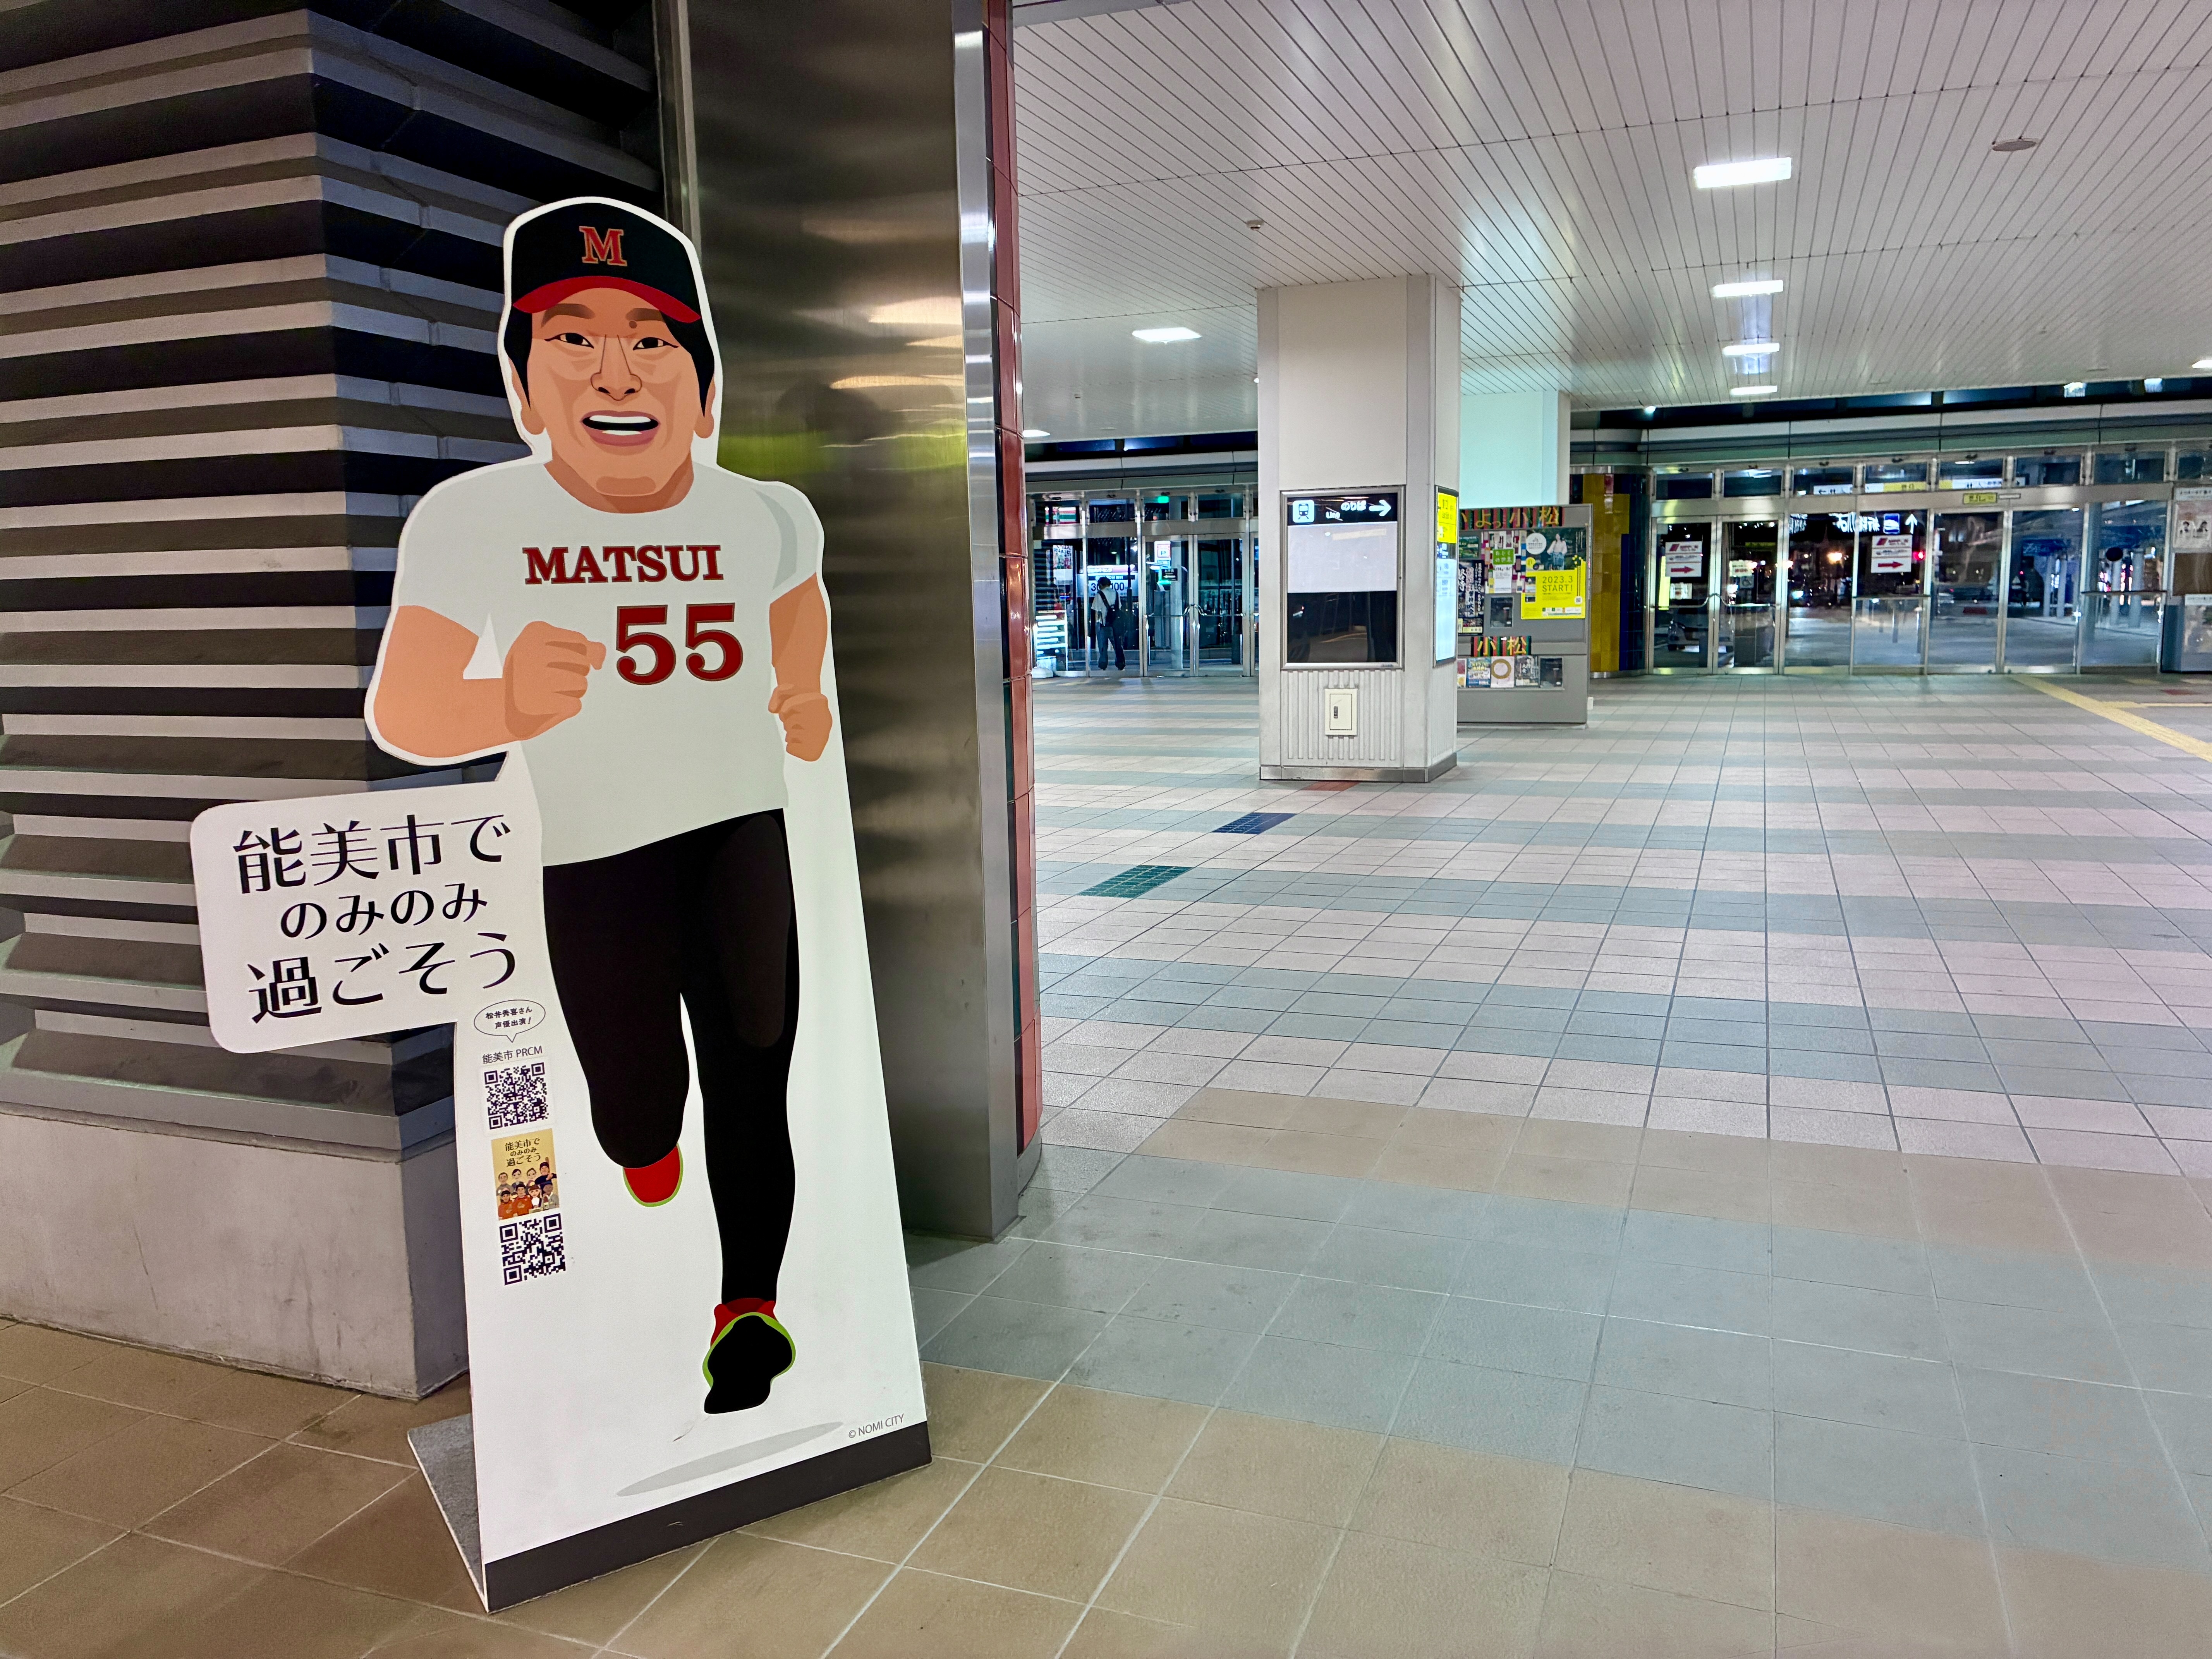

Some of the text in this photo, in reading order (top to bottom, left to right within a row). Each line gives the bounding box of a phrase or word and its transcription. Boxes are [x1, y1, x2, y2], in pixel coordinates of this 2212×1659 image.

[579, 226, 628, 266] M
[1341, 500, 1366, 511] のりば
[522, 545, 724, 584] MATSUI
[616, 603, 743, 685] 55
[1477, 636, 1527, 655] 小松
[233, 814, 511, 894] 能美市で
[280, 883, 487, 939] のみのみ
[247, 933, 515, 1024] 過ごそう
[486, 1006, 532, 1019] 松井秀喜さん
[482, 1046, 543, 1064] 能美市 PRCM
[505, 1137, 540, 1151] 能美市で
[510, 1147, 537, 1156] のみのみ
[506, 1153, 541, 1167] 過ごそう
[858, 1420, 883, 1436] NOMI
[885, 1413, 904, 1427] CITY
